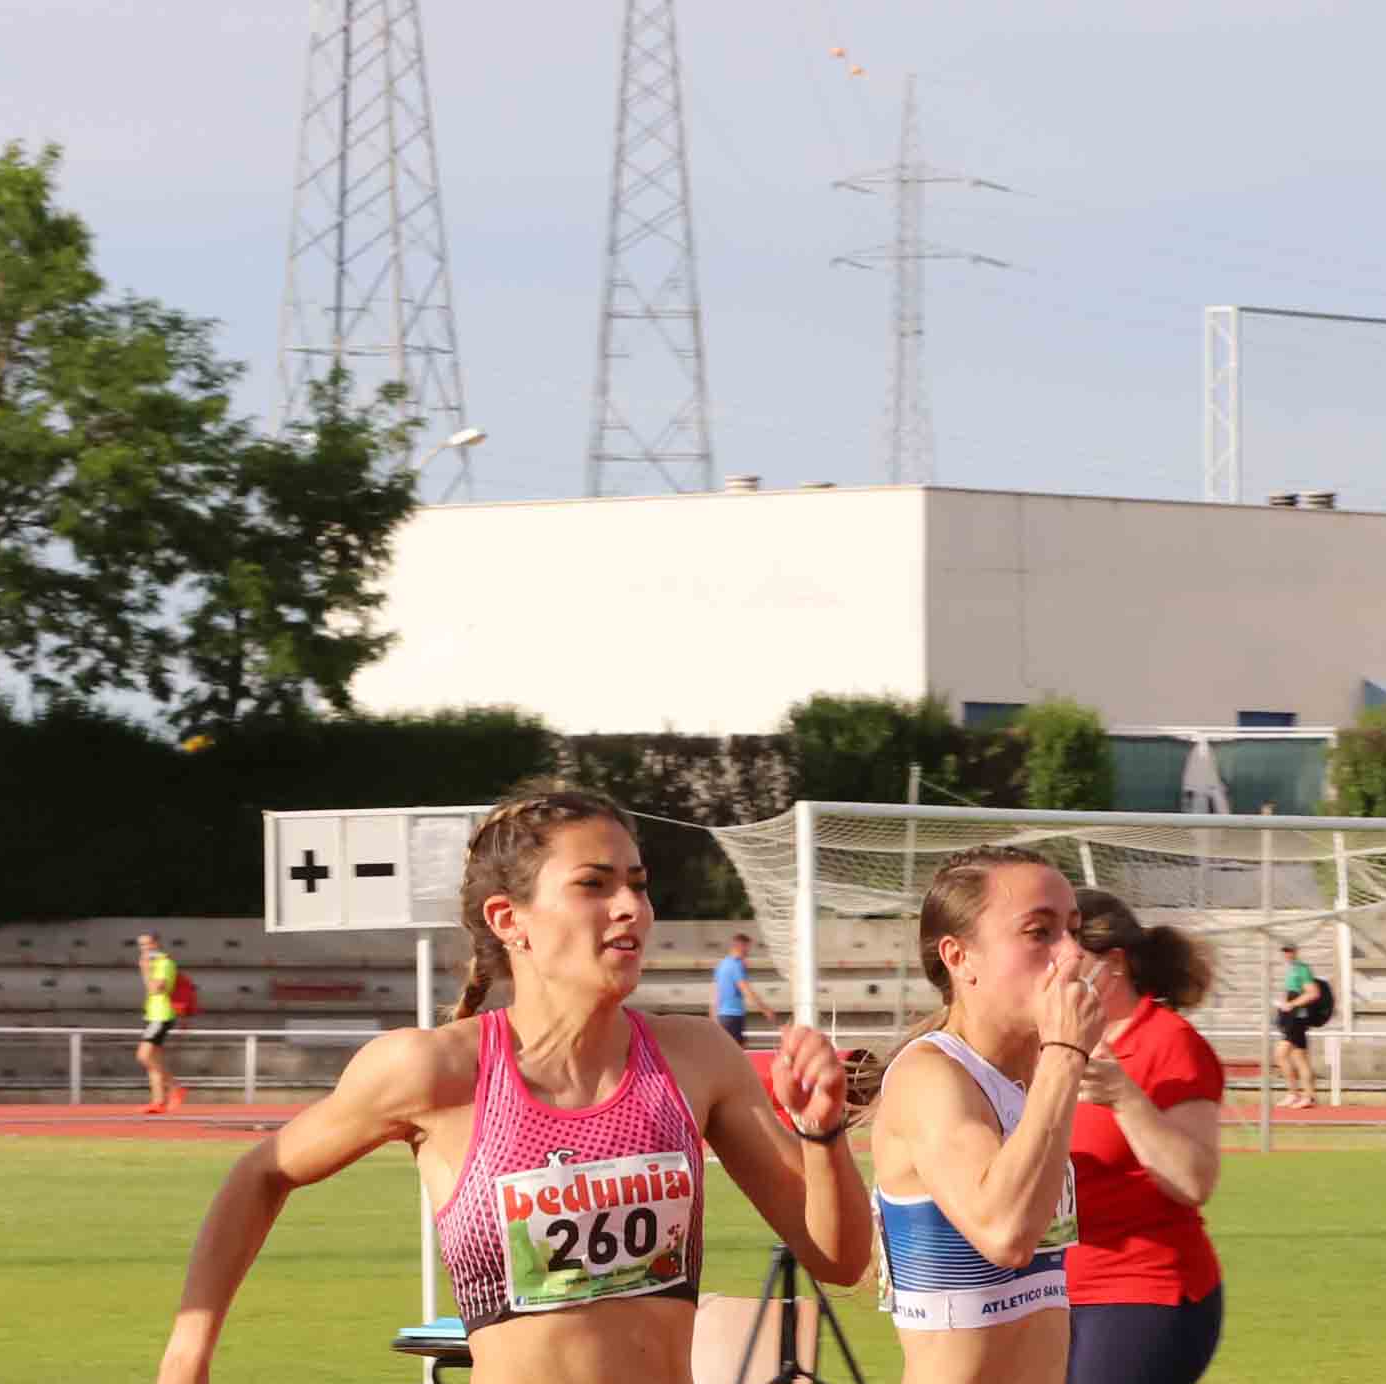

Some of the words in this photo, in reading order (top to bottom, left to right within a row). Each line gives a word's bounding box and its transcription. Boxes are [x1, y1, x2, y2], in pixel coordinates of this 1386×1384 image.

[503, 1163, 691, 1223] bedunia
[546, 1207, 658, 1273] 260
[982, 1288, 1041, 1315] ATLETICO
